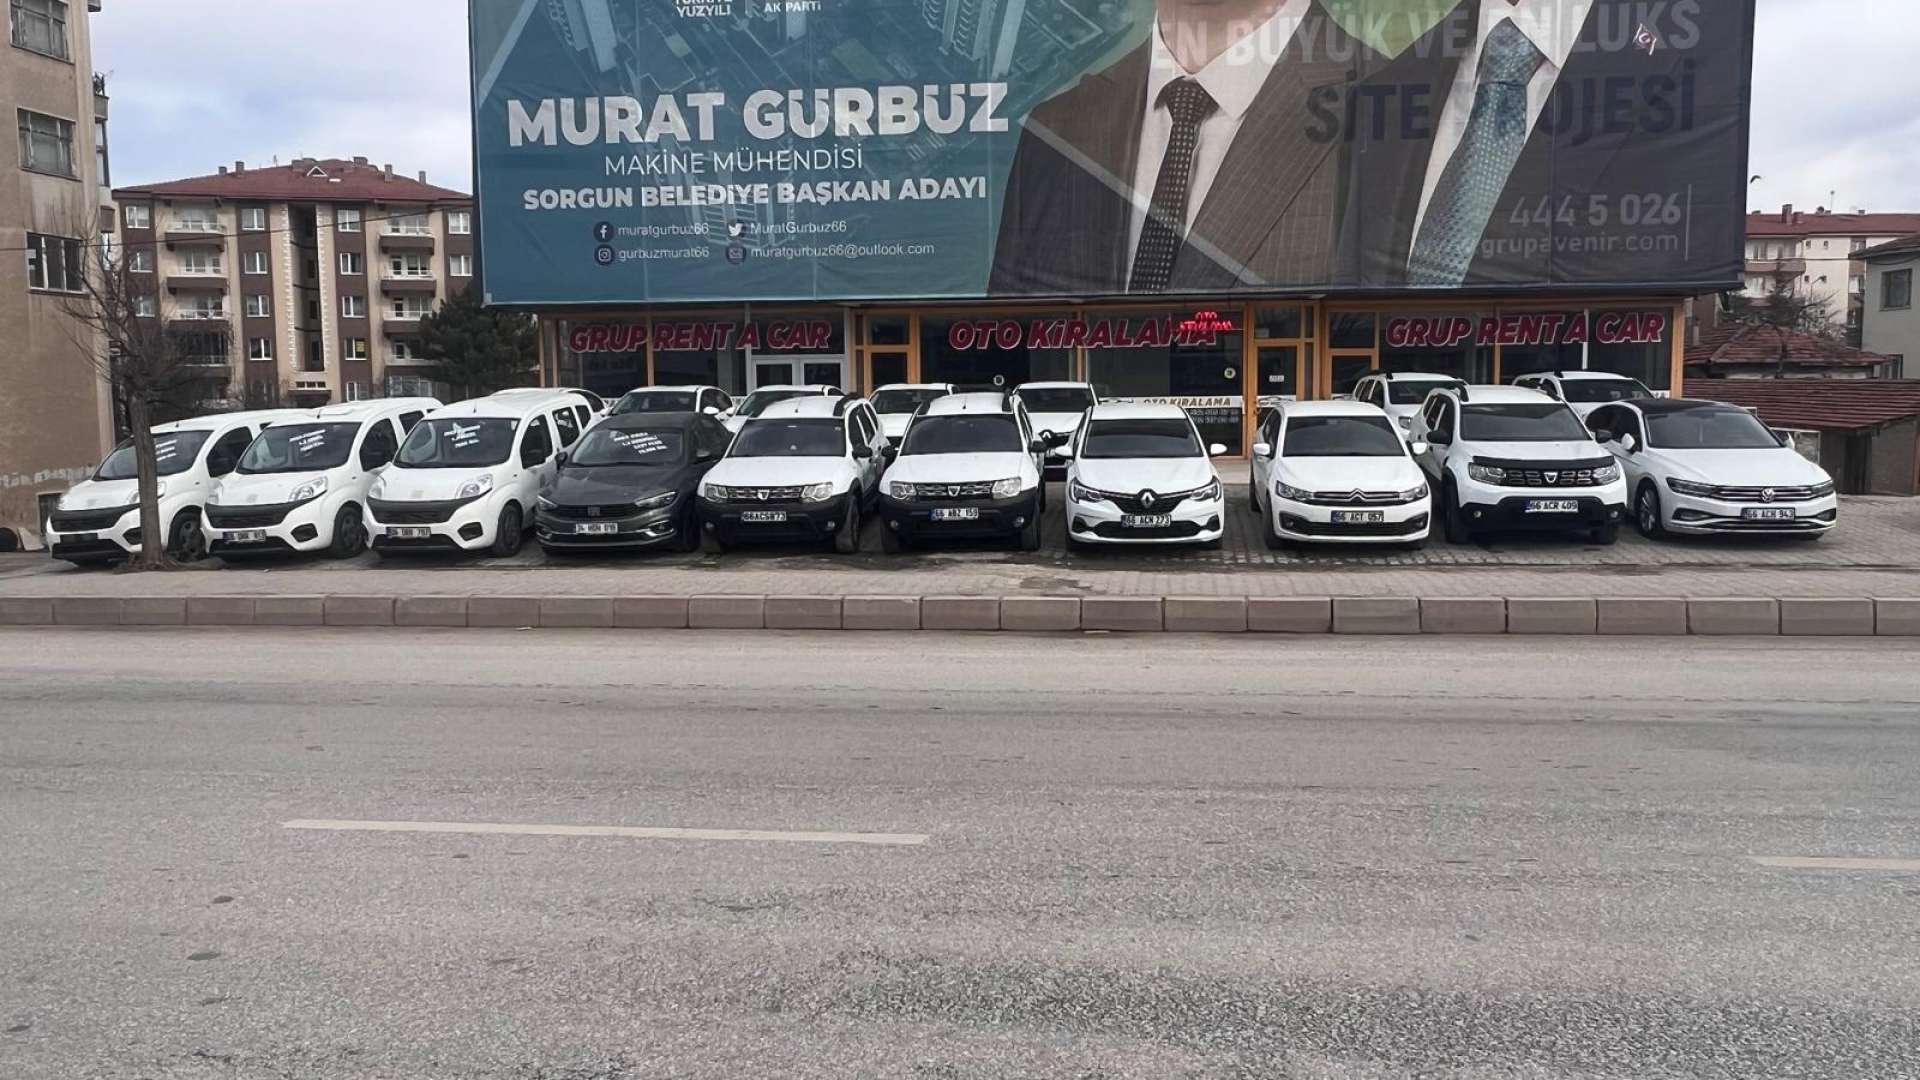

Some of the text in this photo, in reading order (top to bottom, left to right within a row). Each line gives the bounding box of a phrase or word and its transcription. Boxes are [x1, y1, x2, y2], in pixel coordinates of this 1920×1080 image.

[763, 3, 781, 13] AK
[507, 82, 1009, 147] MURAT GÜRBÜZ
[605, 143, 863, 176] MAKİNE MÜHENDİSİ
[522, 176, 987, 210] SORGUN BELEDİYE BAŞKAN ADAYI
[1509, 192, 1682, 228] 444 5 026
[617, 222, 710, 239] muratgurbuz66
[750, 220, 848, 236] MuratGurbuz66
[617, 246, 711, 262] gurbuzmurat66
[569, 319, 833, 353] GRUP RENT A CAR
[949, 319, 1023, 350] OTO
[1386, 311, 1667, 348] GRUP RENT A CAR
